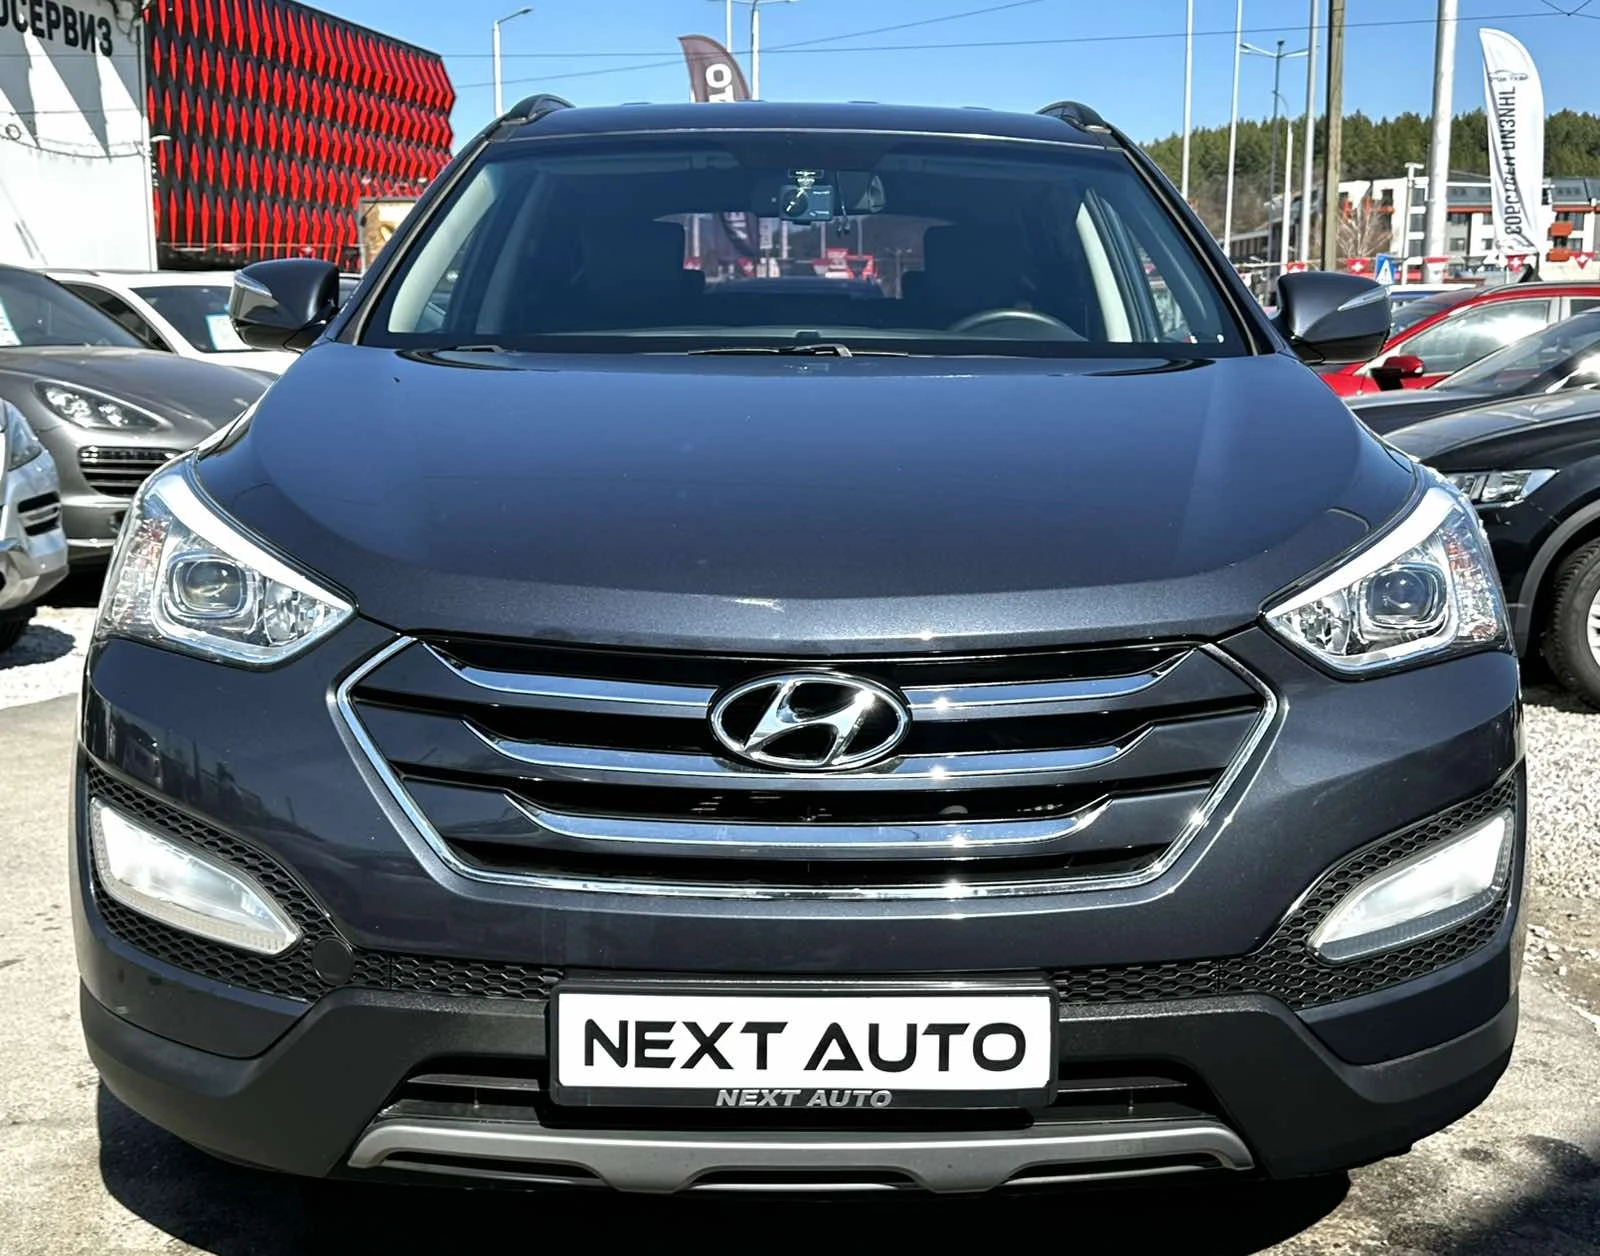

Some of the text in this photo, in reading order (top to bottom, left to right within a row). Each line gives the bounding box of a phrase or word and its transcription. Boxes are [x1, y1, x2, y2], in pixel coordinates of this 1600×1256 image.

[584, 1018, 1026, 1072] NEXT AUTO
[716, 1088, 892, 1108] NEXT AUTO
